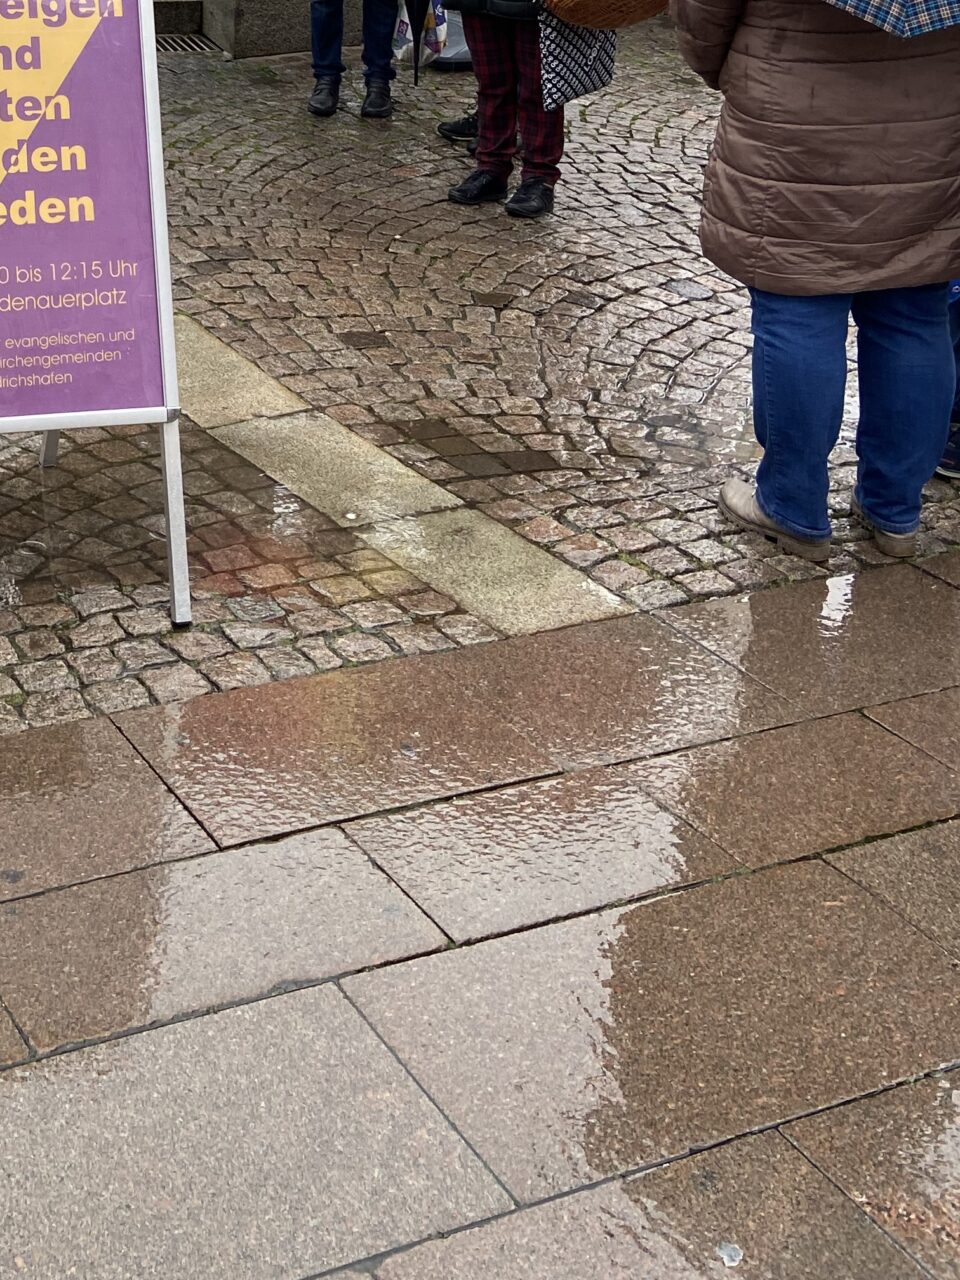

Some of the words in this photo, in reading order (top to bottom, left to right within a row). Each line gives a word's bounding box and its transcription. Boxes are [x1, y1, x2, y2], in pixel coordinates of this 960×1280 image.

[1, 138, 87, 174] den
[15, 264, 42, 283] bis
[49, 260, 103, 280] 12:15
[108, 259, 138, 278] Uhr
[4, 331, 105, 350] evangelischen
[108, 328, 135, 342] und
